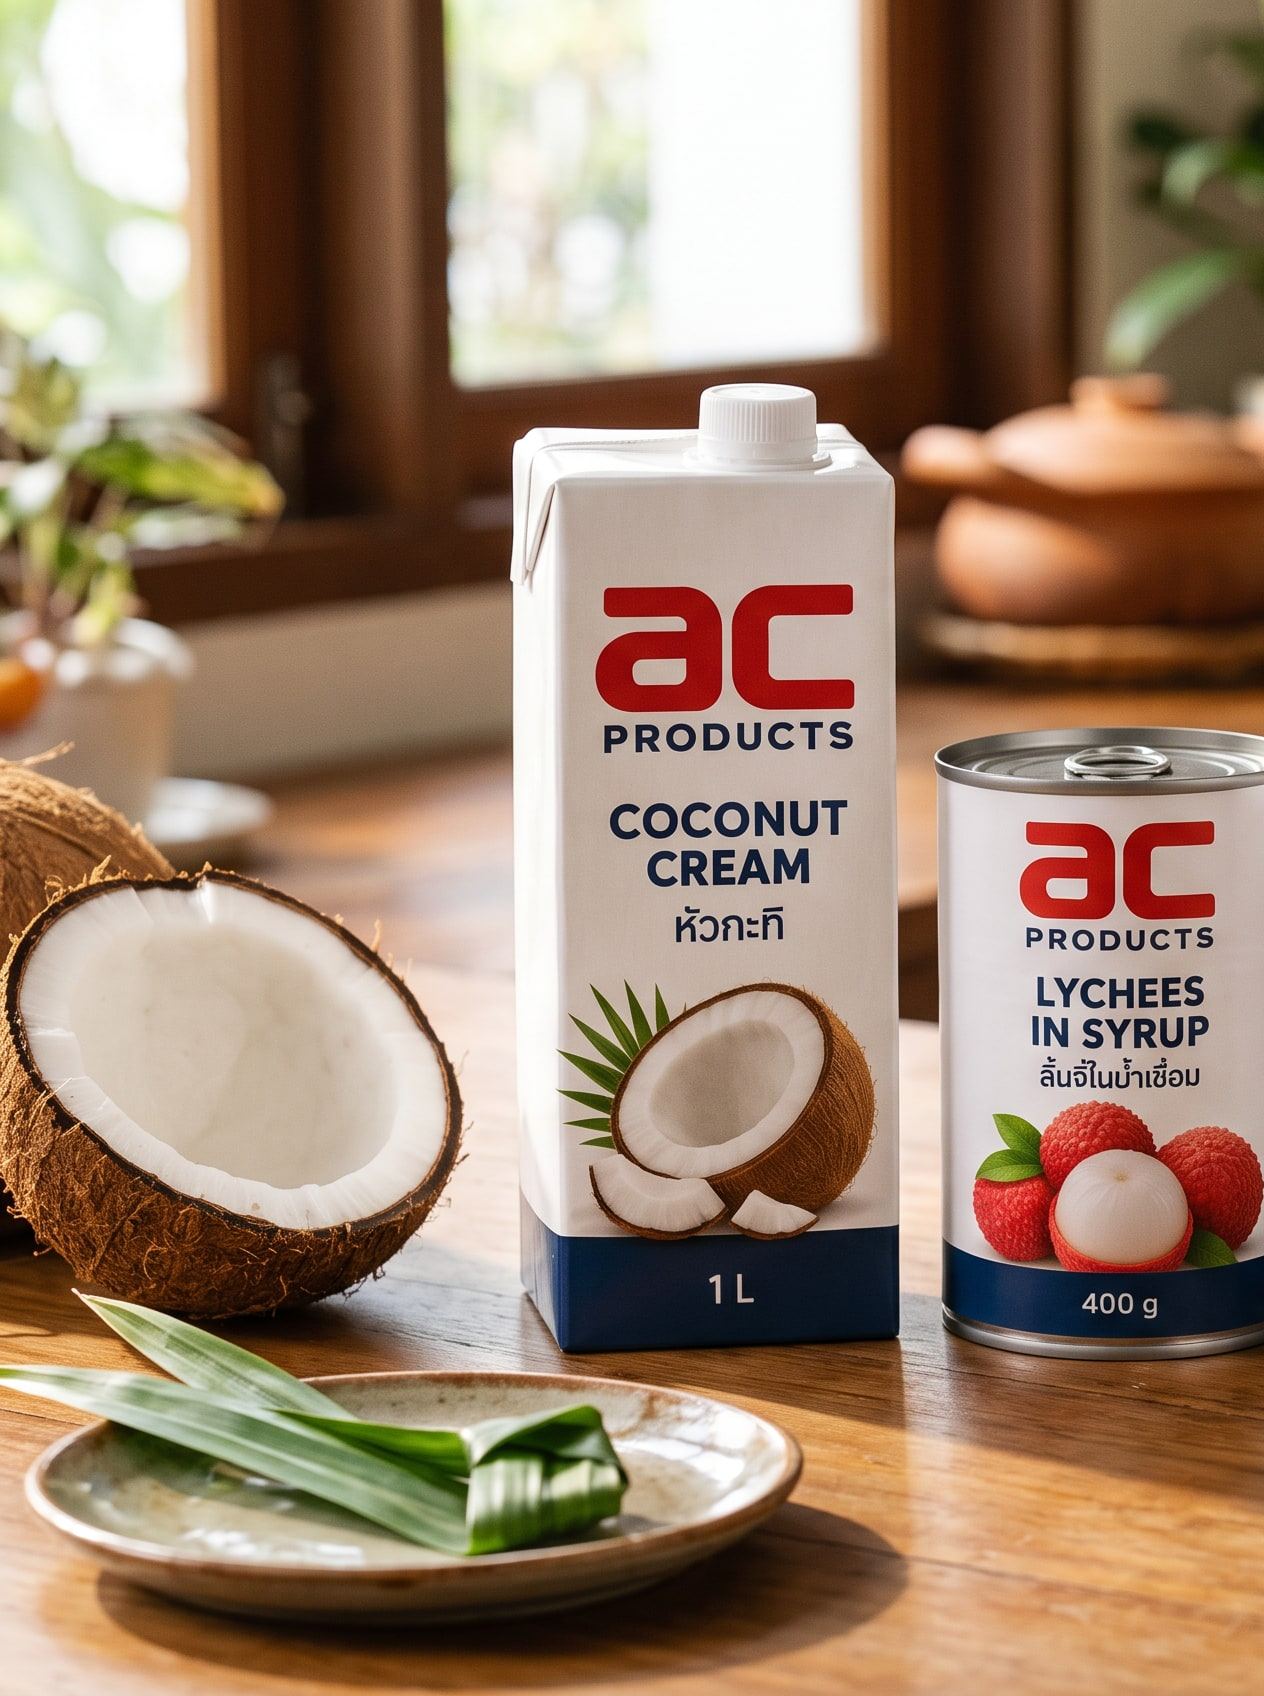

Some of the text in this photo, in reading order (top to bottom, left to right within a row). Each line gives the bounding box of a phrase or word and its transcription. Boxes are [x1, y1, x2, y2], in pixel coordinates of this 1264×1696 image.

[596, 585, 854, 712] ac
[604, 721, 853, 753] PRODUCTS
[610, 800, 847, 839] COCONUT
[647, 848, 809, 887] CREAM
[1020, 821, 1215, 920] ac
[1027, 927, 1213, 951] PRODUCTS
[1038, 976, 1204, 1008] LYCHEES
[1032, 1016, 1209, 1049] IN SYRUP
[709, 1274, 754, 1304] 1 L
[1082, 1293, 1157, 1318] 400 g
